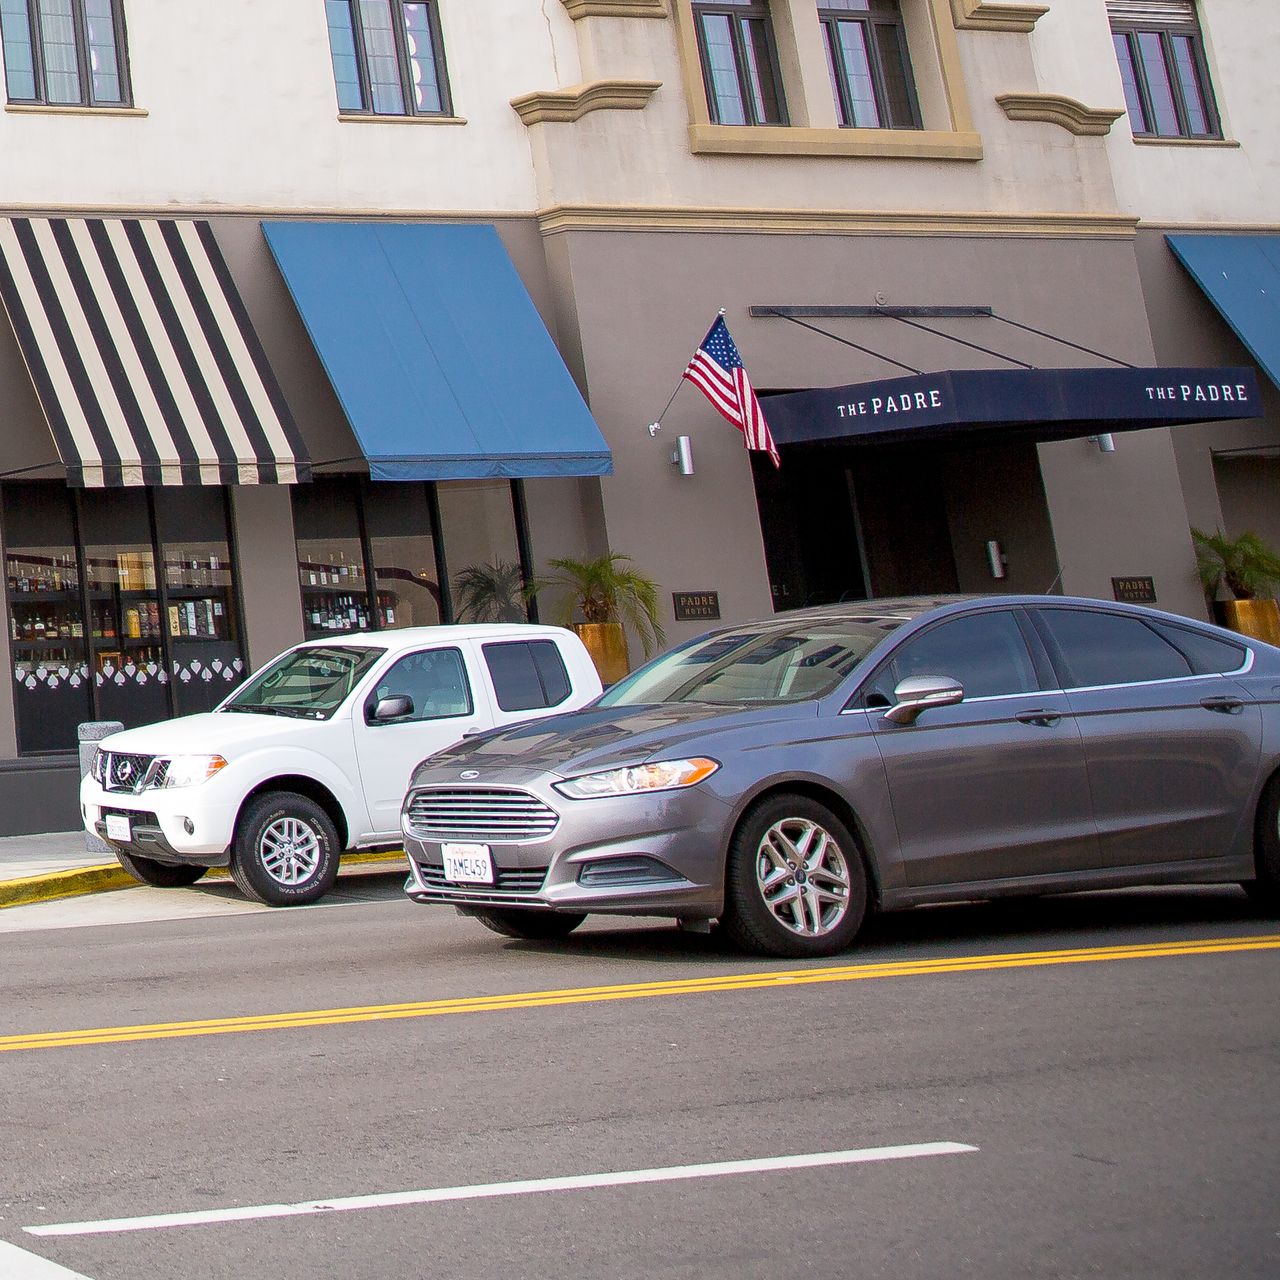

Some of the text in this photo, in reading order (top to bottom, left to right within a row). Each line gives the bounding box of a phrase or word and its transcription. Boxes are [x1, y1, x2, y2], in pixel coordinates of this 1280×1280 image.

[1145, 385, 1248, 401] THE PADRE
[837, 390, 942, 418] THE PADRE
[1119, 581, 1151, 590] PADRE
[680, 596, 715, 606] PADRE
[685, 607, 713, 615] HOTEL
[446, 858, 487, 877] 7AME459
